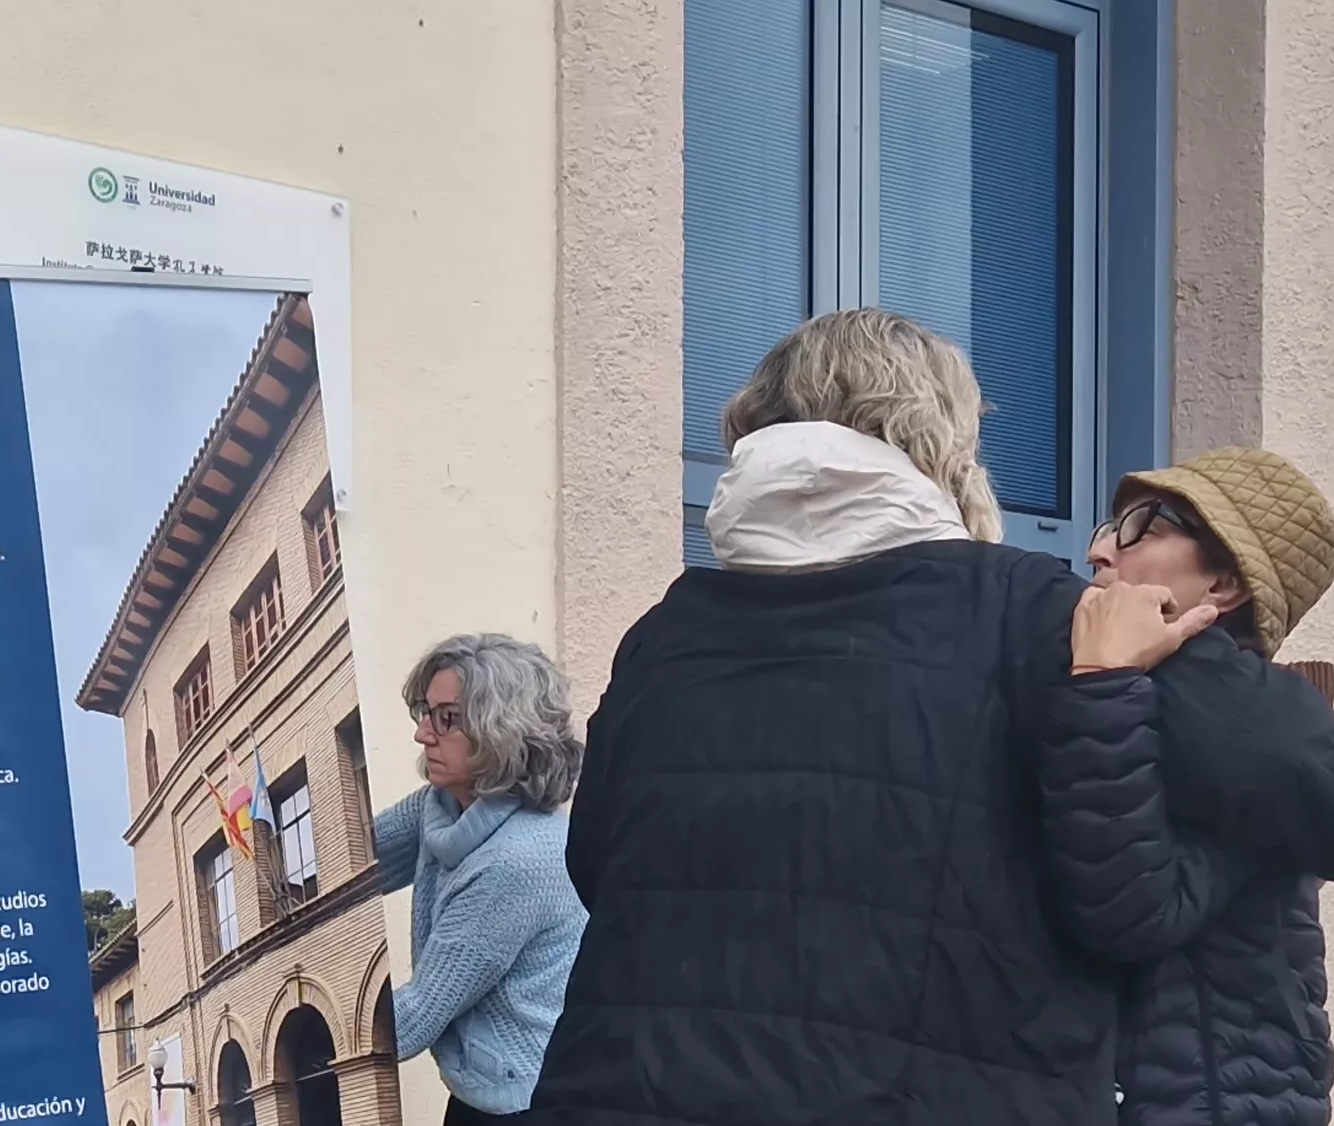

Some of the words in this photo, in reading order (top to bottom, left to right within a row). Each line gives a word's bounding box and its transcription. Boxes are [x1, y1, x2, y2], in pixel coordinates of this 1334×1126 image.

[149, 181, 216, 206] Universidad
[150, 196, 192, 213] Zaragoza
[19, 918, 33, 936] la
[76, 1098, 85, 1115] y
